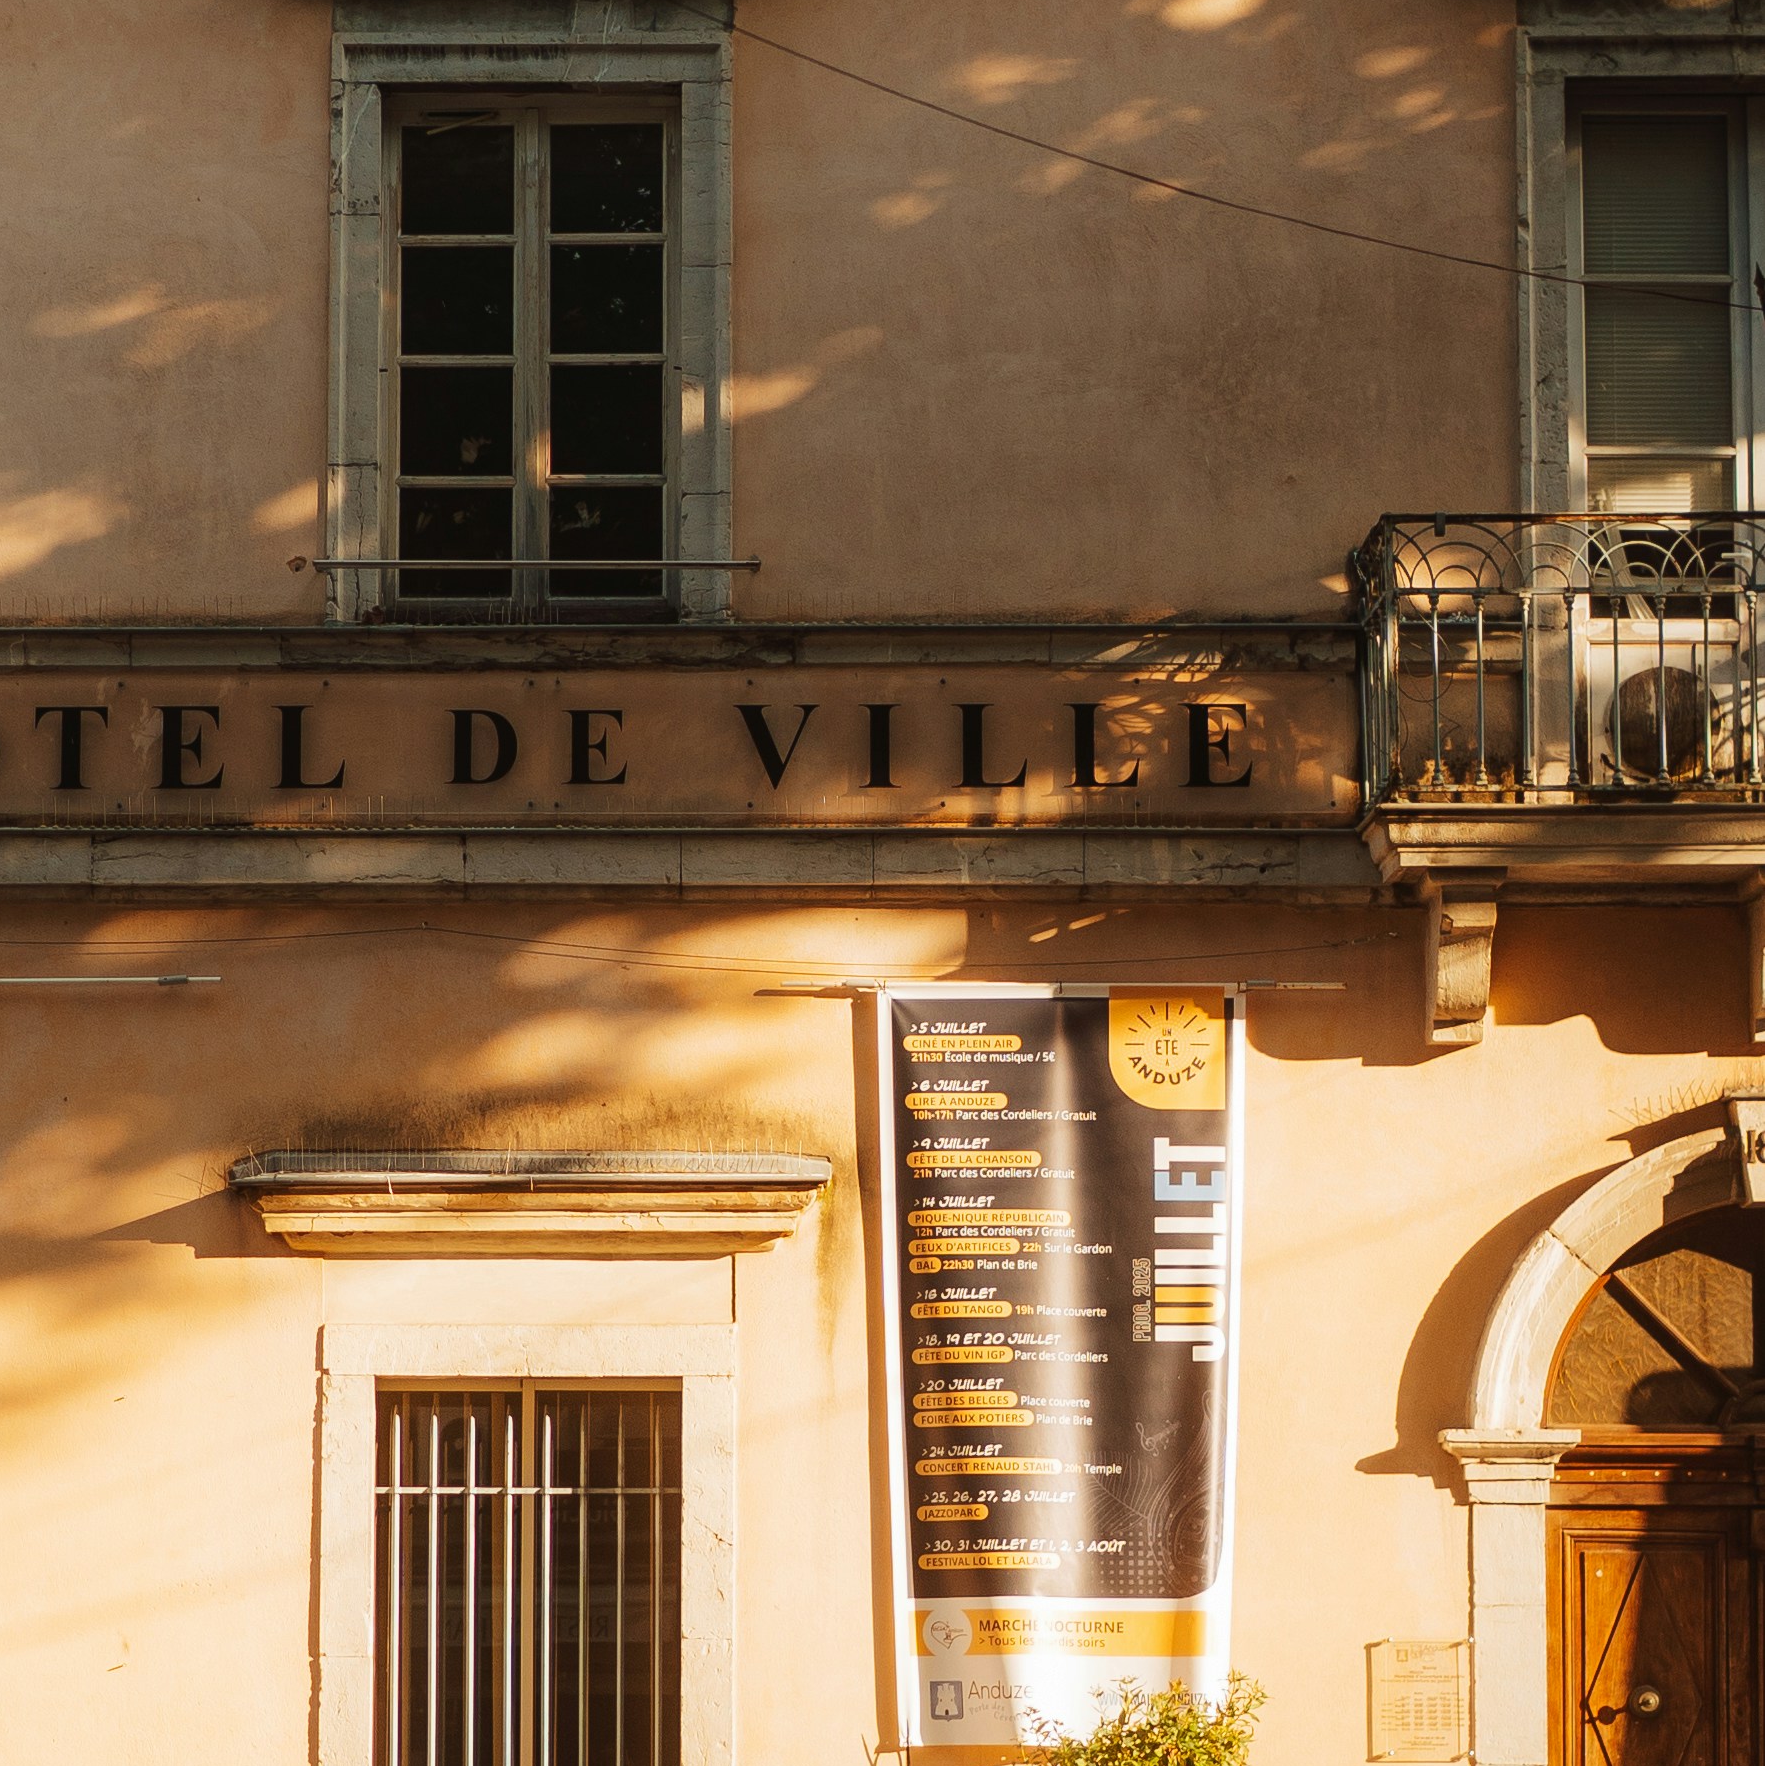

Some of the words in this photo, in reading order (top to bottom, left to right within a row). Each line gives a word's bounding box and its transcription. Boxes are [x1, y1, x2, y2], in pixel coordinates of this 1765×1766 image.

[446, 709, 628, 785] DE
[735, 703, 1256, 790] VILLE
[931, 1022, 987, 1034] JUILLET
[912, 1038, 937, 1048] CINÉ
[942, 1040, 955, 1048] EN
[960, 1040, 991, 1048] PLEIN
[994, 1040, 1013, 1048] AIR
[911, 1053, 942, 1062] 21h30
[945, 1051, 971, 1062] École
[974, 1053, 987, 1062] de
[990, 1053, 1034, 1065] musique
[1043, 1052, 1056, 1062] 5€
[1128, 1057, 1206, 1085] ANDUZE
[934, 1080, 989, 1092] JUILLET
[913, 1097, 936, 1106] LIRE
[939, 1095, 947, 1106] À
[950, 1097, 996, 1106] ANDUZE
[956, 1110, 979, 1120] Parc
[981, 1110, 999, 1120] des
[1001, 1110, 1053, 1120] Cordeliers
[1062, 1110, 1097, 1121] Gratuit
[934, 1138, 990, 1149] JUILLET
[914, 1153, 938, 1164] FÊTE
[942, 1155, 954, 1164] DE
[960, 1155, 973, 1164] LA
[976, 1155, 1032, 1164] CHANSON
[913, 1169, 932, 1178] 21h
[935, 1169, 958, 1178] Parc
[959, 1169, 977, 1178] des
[980, 1168, 1032, 1178] Cordeliers
[1041, 1169, 1075, 1180] Gratuit
[939, 1196, 995, 1208] JUILLET
[915, 1214, 988, 1224] PIQUE-NIQUE
[992, 1211, 1064, 1223] RÉPUBLICAIN
[915, 1227, 933, 1237] 12h
[936, 1227, 958, 1237] Parc
[960, 1227, 978, 1237] des
[981, 1227, 1033, 1237] Cordeliers
[1041, 1227, 1075, 1238] Gratuit
[916, 1243, 942, 1253] FEUX
[1023, 1243, 1041, 1252] 22h
[1045, 1244, 1061, 1253] Sur
[1074, 1244, 1112, 1254] Gardon
[1154, 1137, 1226, 1362] JUILLET
[916, 1261, 936, 1270] BAL
[943, 1260, 974, 1270] 22h30
[977, 1259, 999, 1270] Plan
[1002, 1260, 1014, 1270] de
[1018, 1260, 1038, 1270] Brie
[1133, 1257, 1151, 1297] 2025
[941, 1288, 997, 1300] JUILLET
[918, 1305, 940, 1316] FÊTE
[944, 1306, 959, 1314] DU
[963, 1305, 1003, 1314] TANGO
[1015, 1305, 1034, 1315] 19h
[1037, 1306, 1061, 1316] Place
[1064, 1306, 1107, 1317] couverte
[947, 1334, 960, 1345] 19
[963, 1333, 982, 1345] ET
[983, 1333, 1005, 1345] 20
[1008, 1334, 1061, 1345] JUILLET
[919, 1350, 941, 1361] FÊTE
[945, 1352, 960, 1360] DU
[965, 1351, 983, 1360] VIN
[987, 1351, 1005, 1359] IGP
[1015, 1351, 1037, 1361] Parc
[1039, 1351, 1056, 1361] des
[1058, 1351, 1108, 1363] Cordeliers
[949, 1378, 1004, 1390] JUILLET
[921, 1395, 942, 1406] FÊTE
[946, 1397, 965, 1405] DES
[968, 1396, 1009, 1405] BELGES
[1021, 1395, 1046, 1406] Place
[1049, 1396, 1090, 1408] couverte
[922, 1415, 950, 1424] FOIRE
[952, 1414, 975, 1423] AUX
[979, 1413, 1025, 1423] POTIERS
[1036, 1414, 1056, 1424] Plan
[1059, 1414, 1071, 1424] de
[1073, 1415, 1093, 1426] Brie
[948, 1444, 1003, 1457] JUILLET
[923, 1462, 969, 1473] CONCERT
[973, 1461, 1019, 1471] RENAUD
[1084, 1464, 1122, 1476] Temple
[1002, 1490, 1021, 1502] 28
[1025, 1491, 1076, 1503] JUILLET
[924, 1509, 980, 1520] JAZZOPARC
[957, 1540, 969, 1551] 31
[973, 1539, 1026, 1551] JUILLET
[1029, 1539, 1048, 1551] ET
[1075, 1540, 1084, 1551] 3
[1087, 1539, 1127, 1553] AOÛT
[926, 1557, 970, 1567] FESTIVAL
[974, 1557, 993, 1566] LOL
[997, 1556, 1009, 1565] ET
[1013, 1556, 1052, 1566] LALALA
[988, 1635, 1015, 1646] Tous
[1020, 1636, 1034, 1646] les
[1041, 1636, 1074, 1647] dis
[1077, 1638, 1105, 1647] soirs
[968, 1681, 1033, 1699] Anduze
